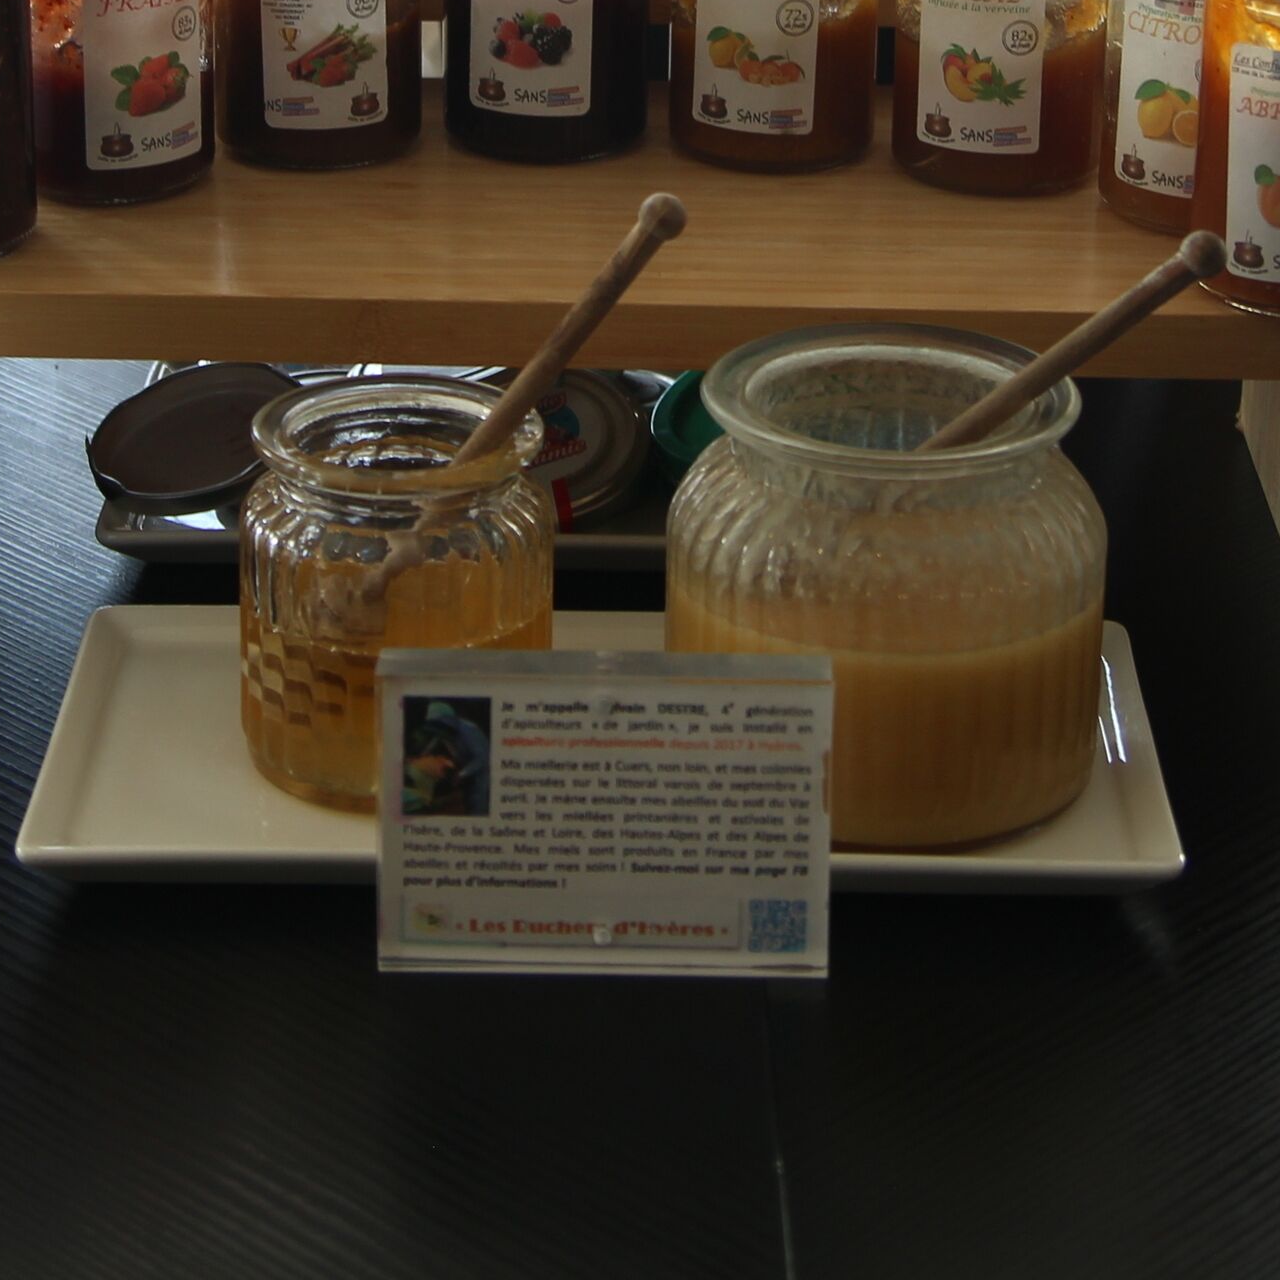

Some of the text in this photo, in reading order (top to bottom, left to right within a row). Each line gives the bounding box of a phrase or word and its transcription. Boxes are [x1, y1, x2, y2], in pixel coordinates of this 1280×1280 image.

[961, 1, 968, 10] à
[971, 2, 981, 11] la
[984, 5, 1031, 14] verveine
[1128, 10, 1202, 45] CITRO
[514, 88, 547, 104] SANS
[736, 108, 770, 124] SANS
[141, 132, 172, 152] SANS
[959, 126, 993, 143] SANS
[1152, 170, 1184, 190] SANS
[469, 918, 506, 933] Les
